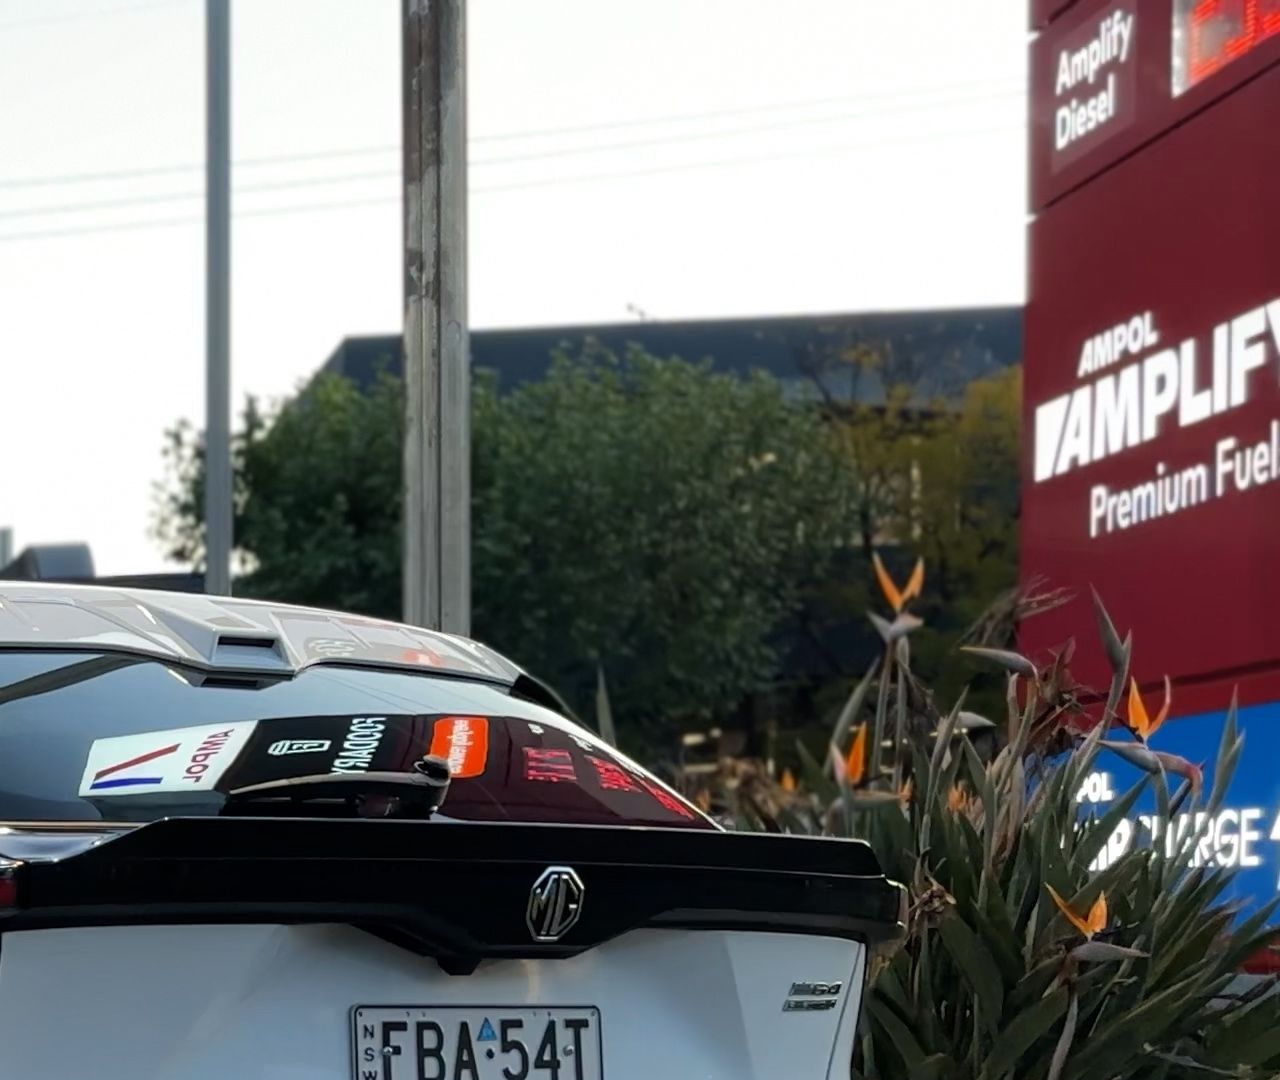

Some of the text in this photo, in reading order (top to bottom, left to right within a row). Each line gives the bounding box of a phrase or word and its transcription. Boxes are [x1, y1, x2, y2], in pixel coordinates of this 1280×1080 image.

[1055, 10, 1133, 95] Amplify
[1055, 74, 1116, 150] Diesel
[1077, 311, 1159, 378] AMPOL
[1090, 461, 1208, 538] Premium
